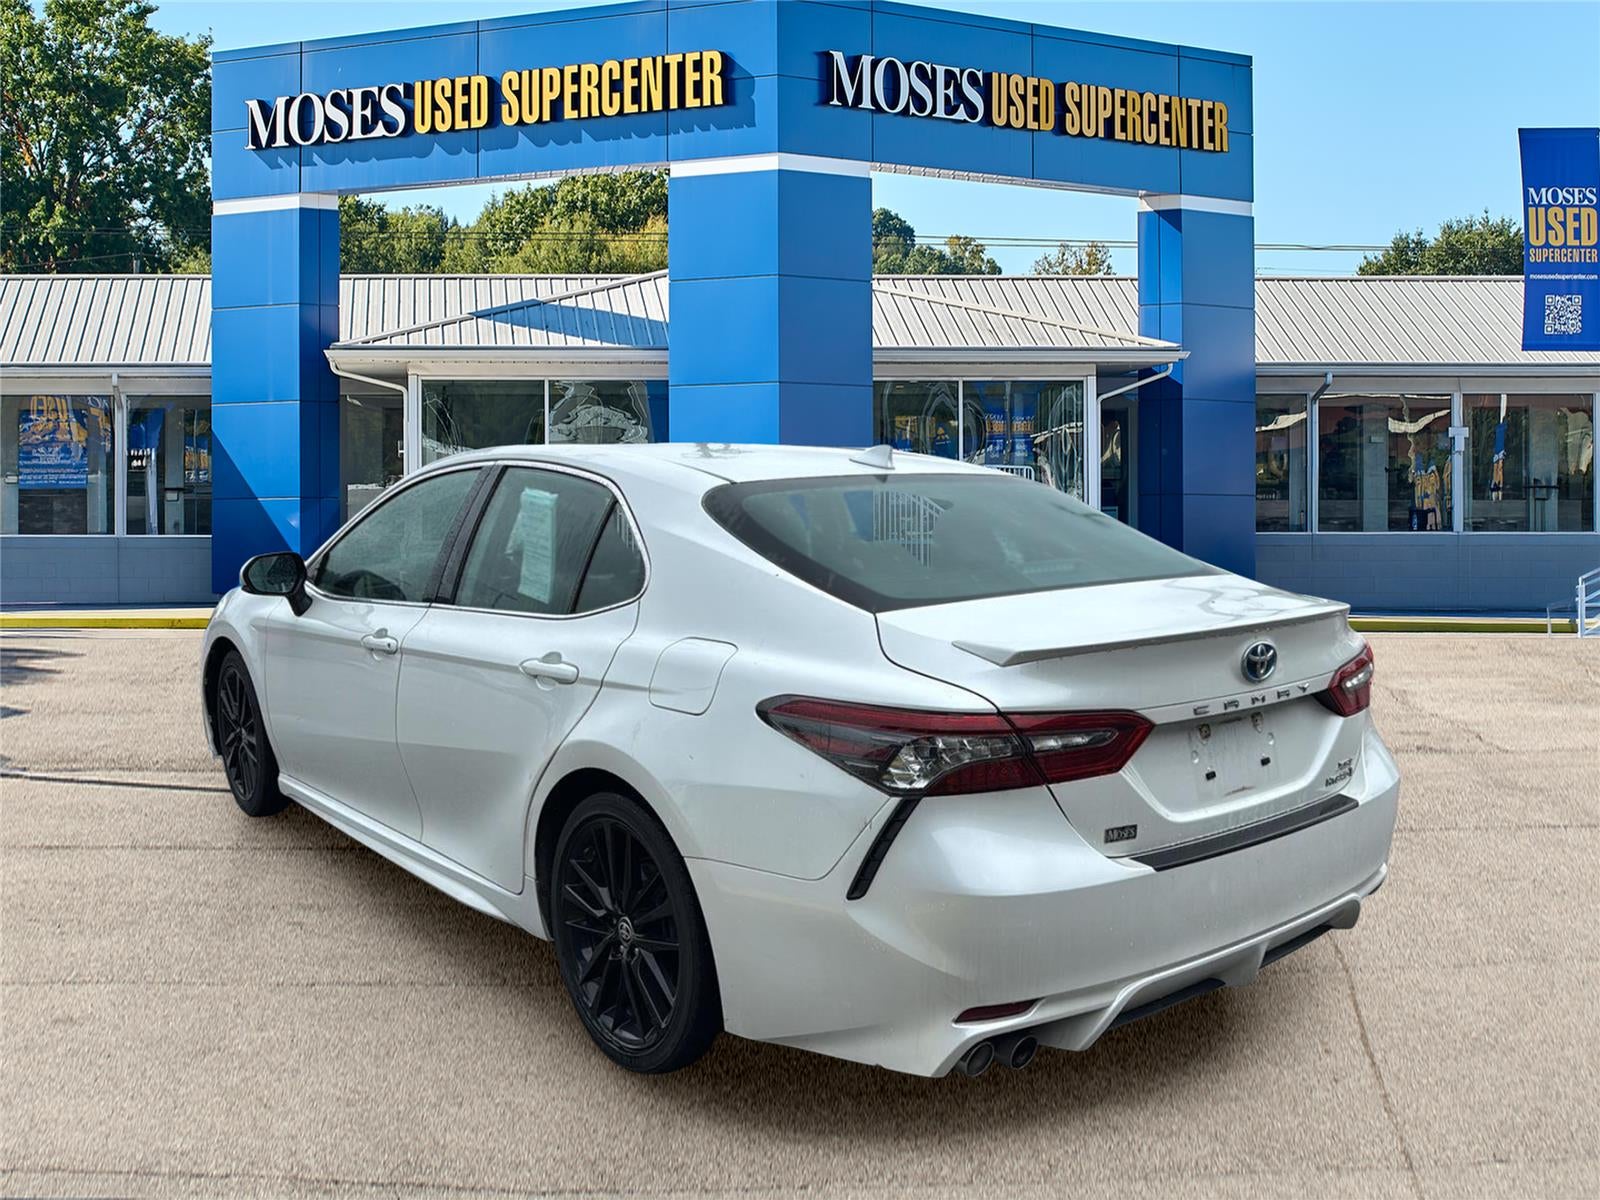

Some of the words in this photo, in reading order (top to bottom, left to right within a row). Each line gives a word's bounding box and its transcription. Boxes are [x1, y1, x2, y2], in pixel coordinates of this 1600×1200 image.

[244, 84, 407, 150] MOSES
[413, 75, 488, 135] USED
[501, 50, 725, 128] SUPERCENTER
[829, 50, 984, 124] MOSES
[991, 71, 1055, 131] USED
[1065, 81, 1229, 152] SUPERCENTER
[1527, 187, 1597, 206] MOSES
[1528, 207, 1598, 246] USED
[1529, 248, 1598, 263] SUPERCENTER
[1193, 682, 1310, 716] CAMRY
